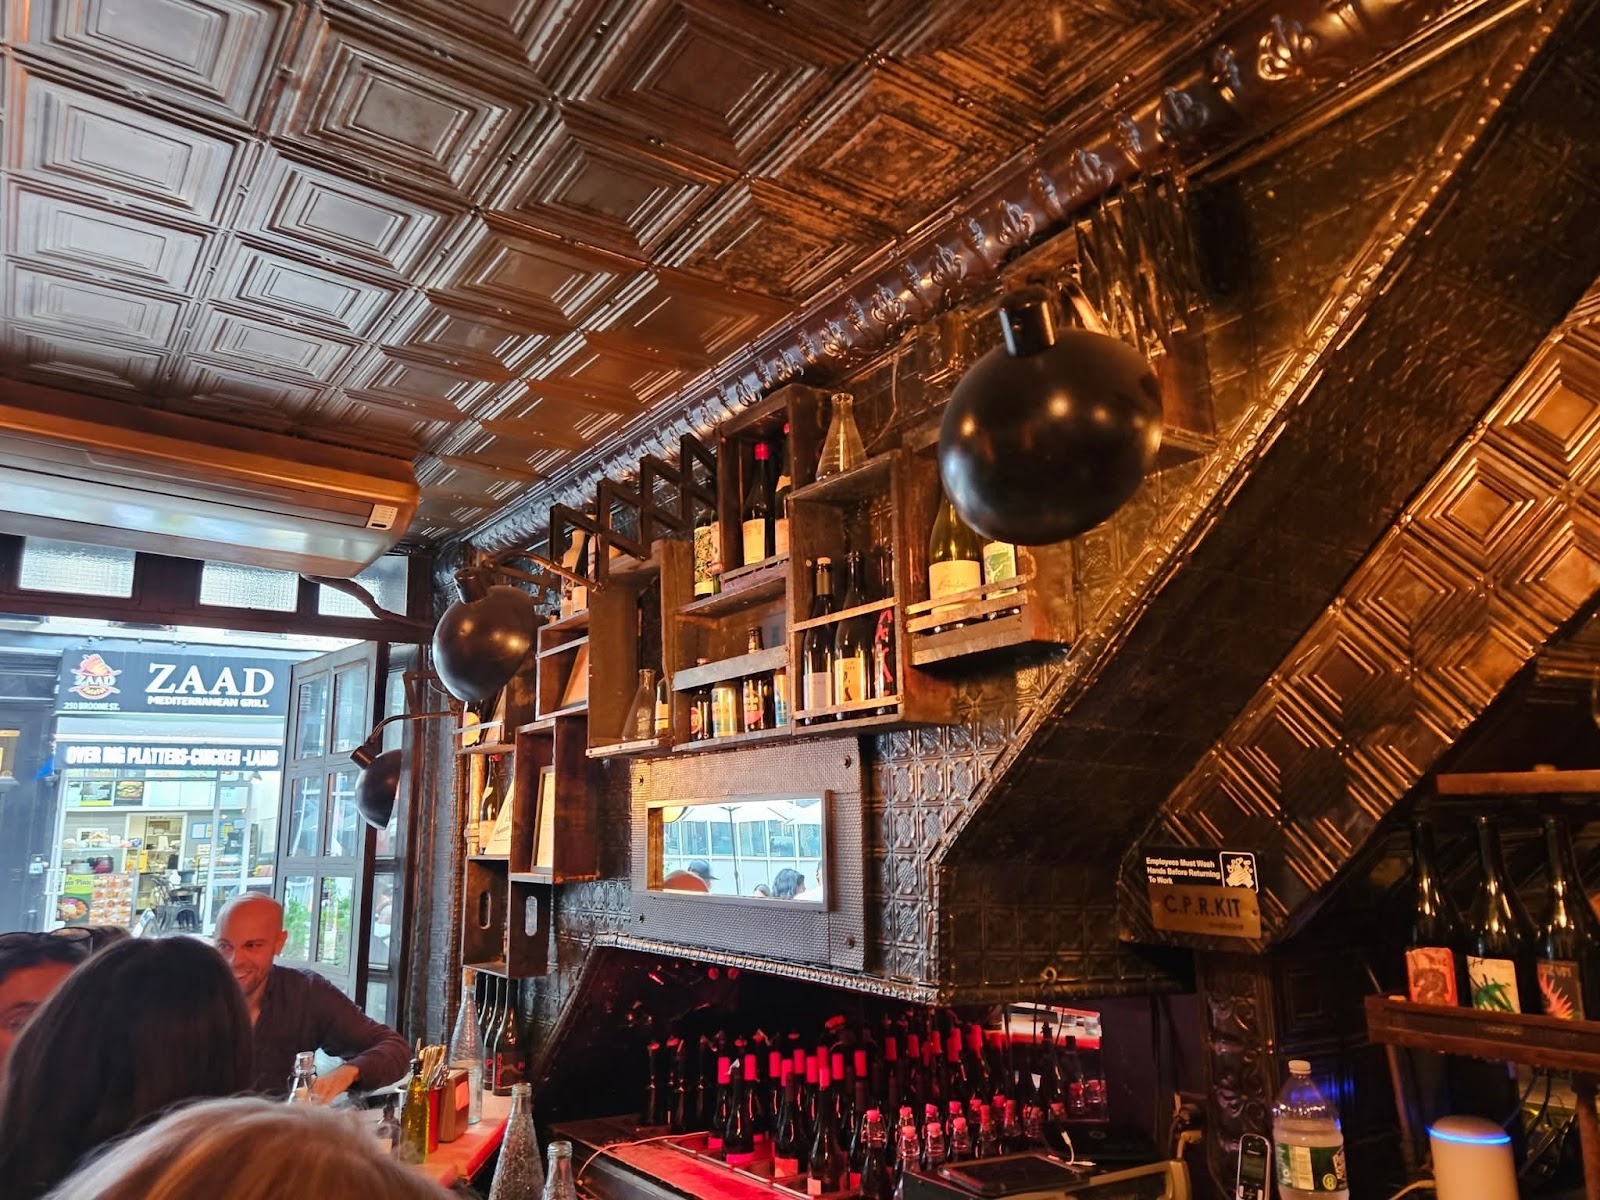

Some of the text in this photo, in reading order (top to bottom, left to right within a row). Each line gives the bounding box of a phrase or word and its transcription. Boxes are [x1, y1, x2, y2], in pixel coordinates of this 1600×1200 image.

[145, 662, 274, 696] ZAAD
[147, 695, 270, 708] MEDITERRANEAN GRILL
[1146, 857, 1215, 868] Employees Must Wash
[1147, 867, 1221, 880] Hands Before Returning
[1157, 876, 1173, 884] Work
